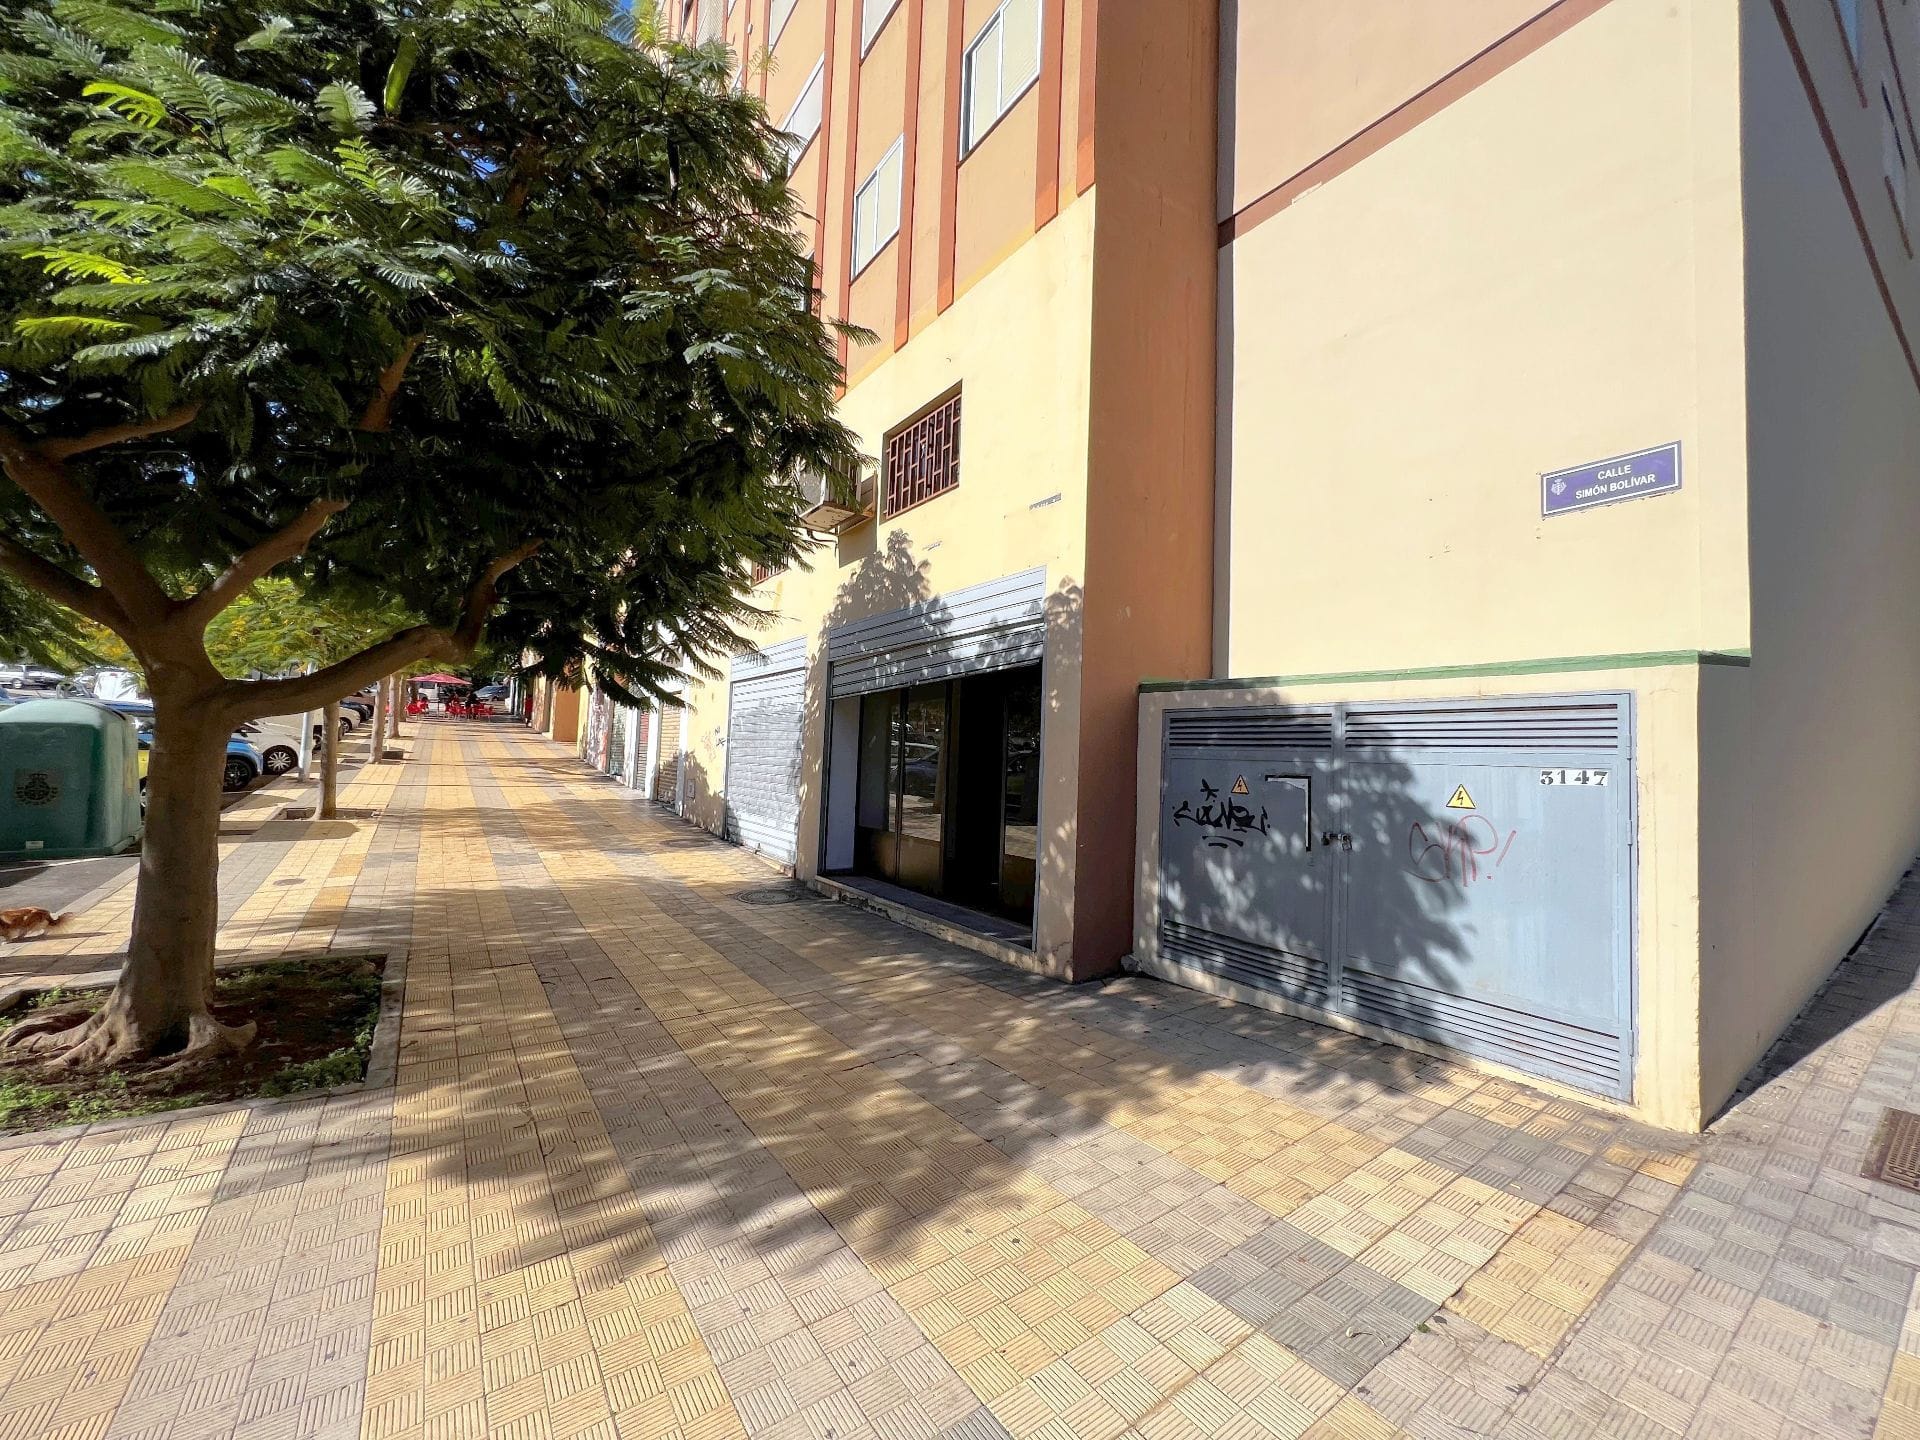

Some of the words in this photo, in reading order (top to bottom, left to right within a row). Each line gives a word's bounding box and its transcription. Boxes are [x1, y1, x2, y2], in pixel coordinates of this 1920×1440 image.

[1597, 464, 1631, 480] CALLE
[1575, 484, 1607, 499] SIMÓN
[1609, 473, 1656, 492] BOLÍVAR
[1540, 769, 1609, 786] 3147
